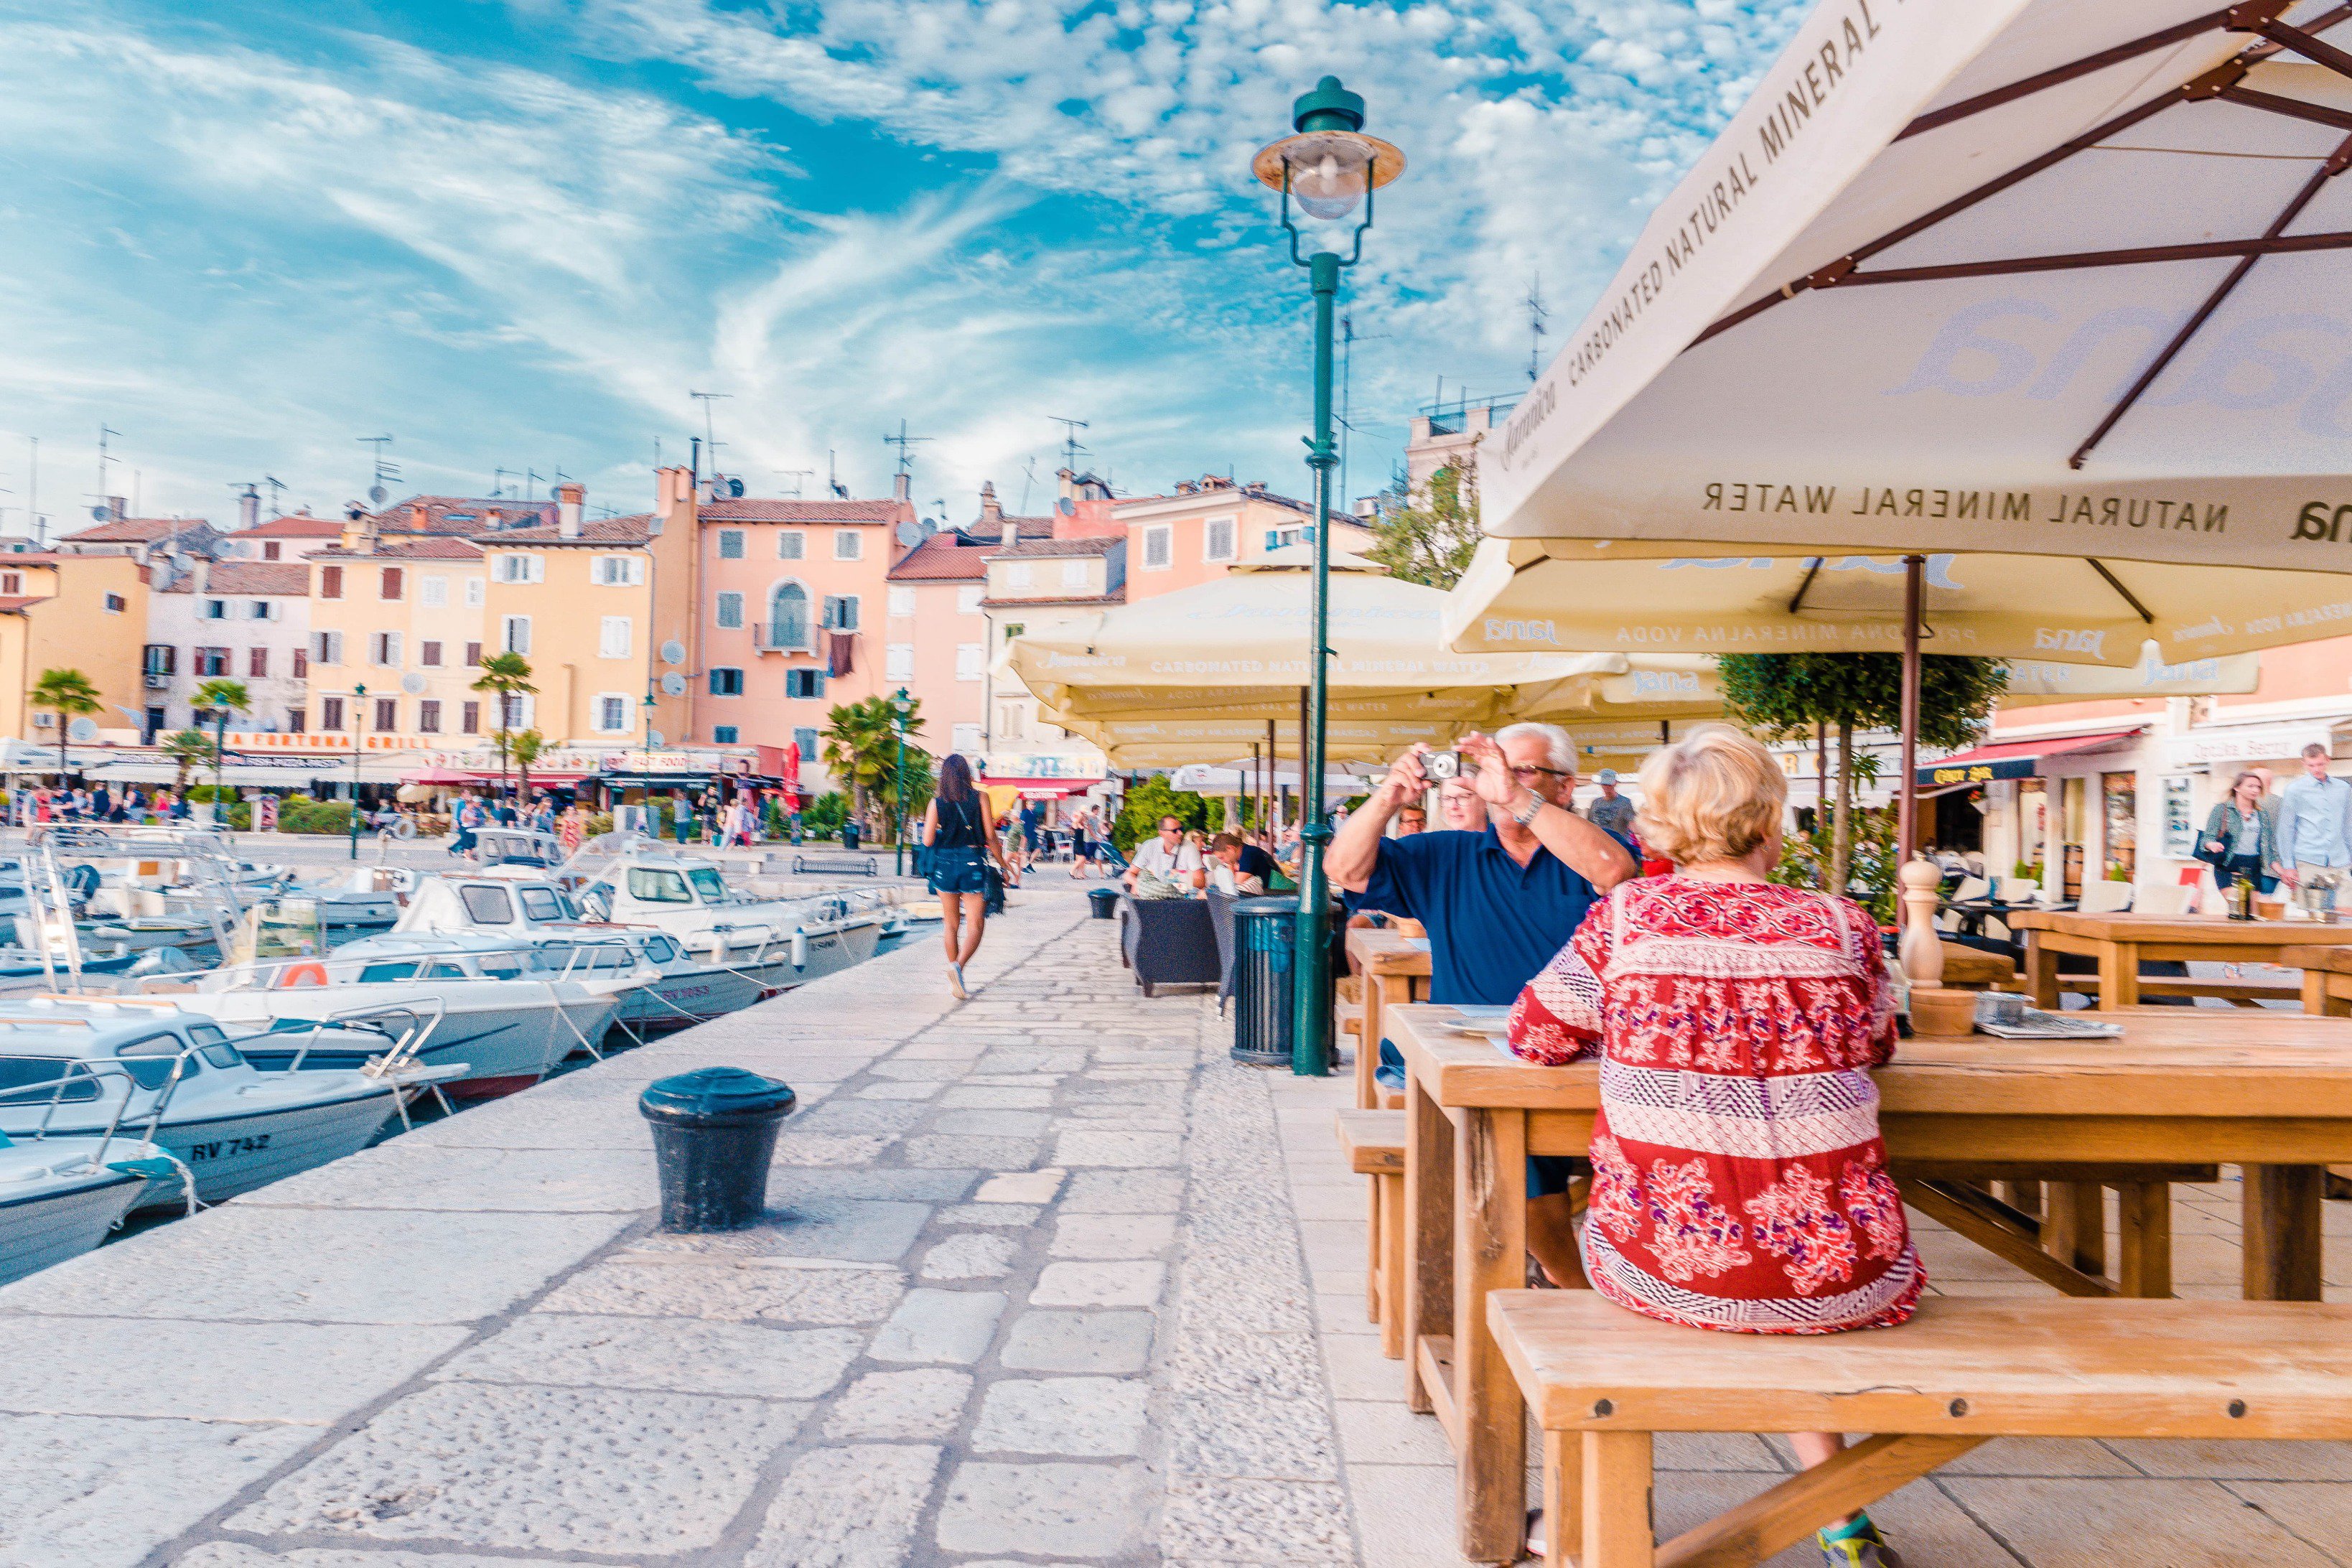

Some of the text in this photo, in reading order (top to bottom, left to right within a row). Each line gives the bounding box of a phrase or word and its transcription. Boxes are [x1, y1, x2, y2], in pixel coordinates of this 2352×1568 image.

[1568, 260, 1663, 387] CARBONATED
[1665, 151, 1758, 277] NATURAL
[1758, 0, 1881, 164] MINERAL
[1150, 660, 1263, 673] CARBONATED
[1352, 660, 1426, 673] MINERAL
[1433, 661, 1490, 674] WATER
[1630, 669, 1701, 696] jana
[254, 733, 350, 747] FORTUNA
[367, 736, 431, 749] GRILL
[191, 1142, 222, 1161] RV
